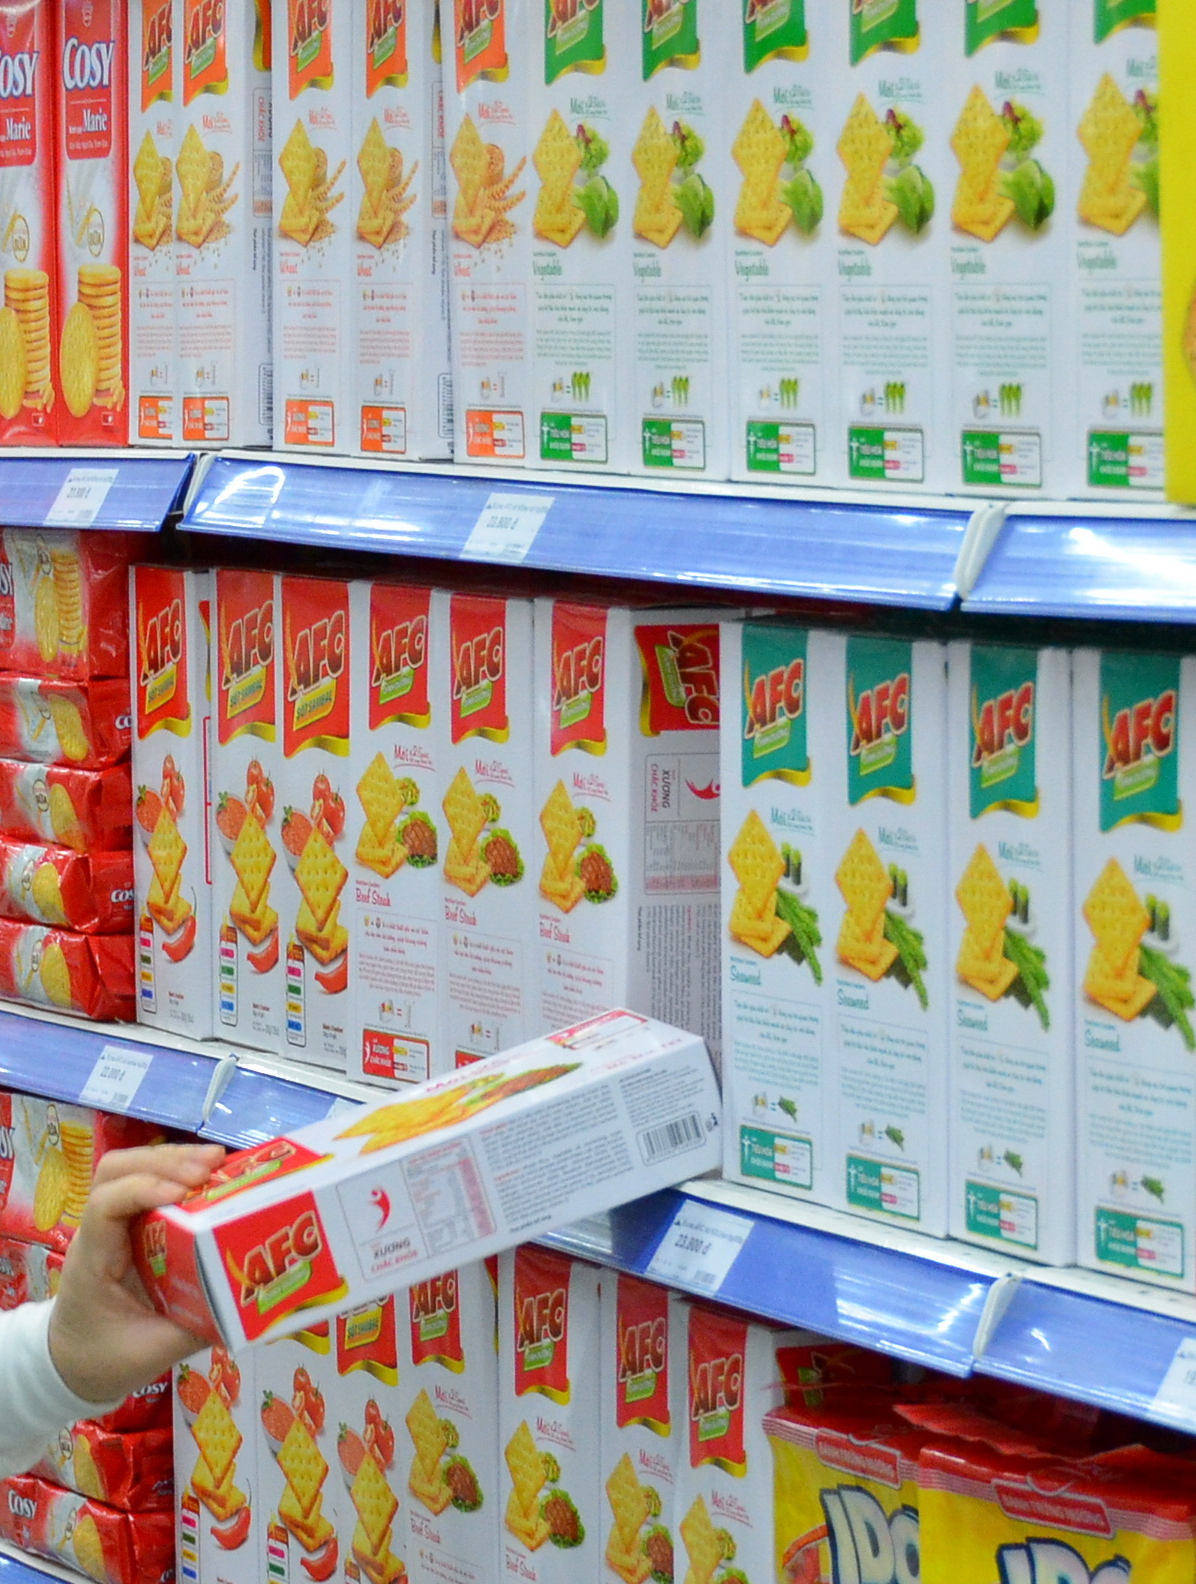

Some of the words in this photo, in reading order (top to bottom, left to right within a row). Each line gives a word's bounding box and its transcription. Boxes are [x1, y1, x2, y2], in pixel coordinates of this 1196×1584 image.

[140, 598, 182, 687] AFC
[221, 600, 274, 690] AFC
[288, 610, 345, 702] AFC
[371, 614, 427, 687] AFC
[453, 627, 503, 700] AFC
[553, 636, 603, 711] AFC
[115, 714, 132, 731] CO
[744, 657, 804, 739] AFC
[850, 672, 910, 756] AFC
[972, 680, 1035, 769] AFC
[1102, 689, 1177, 780] AFC
[110, 888, 134, 904] COS
[241, 1210, 323, 1308] AFC
[516, 1288, 566, 1352] AFC
[618, 1317, 666, 1383] AFC
[691, 1353, 743, 1422] AFC
